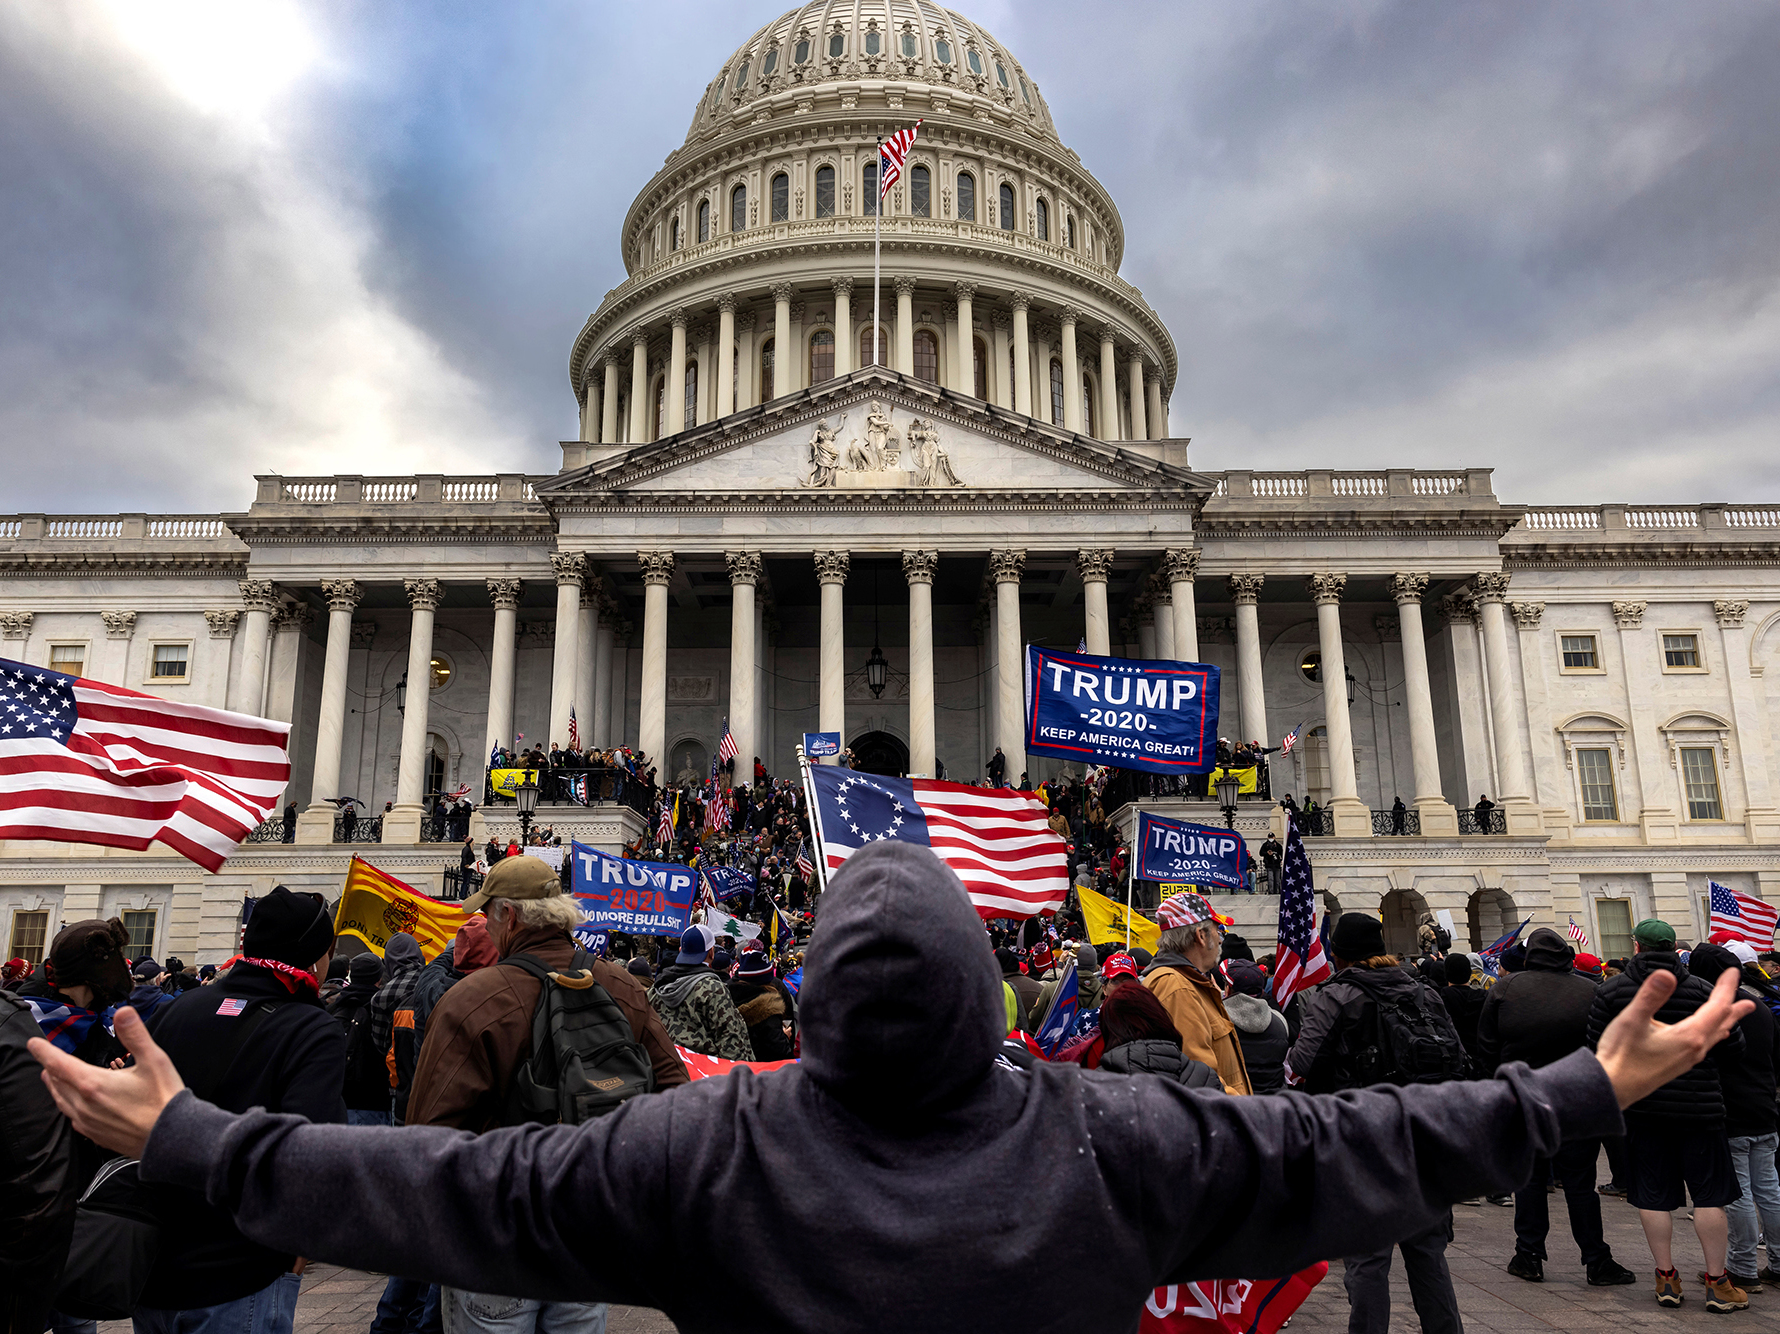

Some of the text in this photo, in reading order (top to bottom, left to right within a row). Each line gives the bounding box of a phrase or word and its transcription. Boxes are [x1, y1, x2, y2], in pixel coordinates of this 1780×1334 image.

[1047, 662, 1196, 710] TRUMP
[1080, 708, 1157, 732] -2020-
[1040, 726, 1194, 756] KEEP AMERICA GREAT!
[1152, 826, 1236, 858] TRUMP
[578, 852, 690, 892] TRUMP
[1168, 858, 1217, 870] -2020-
[1147, 869, 1169, 877] KEEP
[1213, 872, 1240, 886] GREAT!
[610, 888, 665, 912] 2020
[579, 910, 595, 922] NO
[596, 911, 634, 925] MORE
